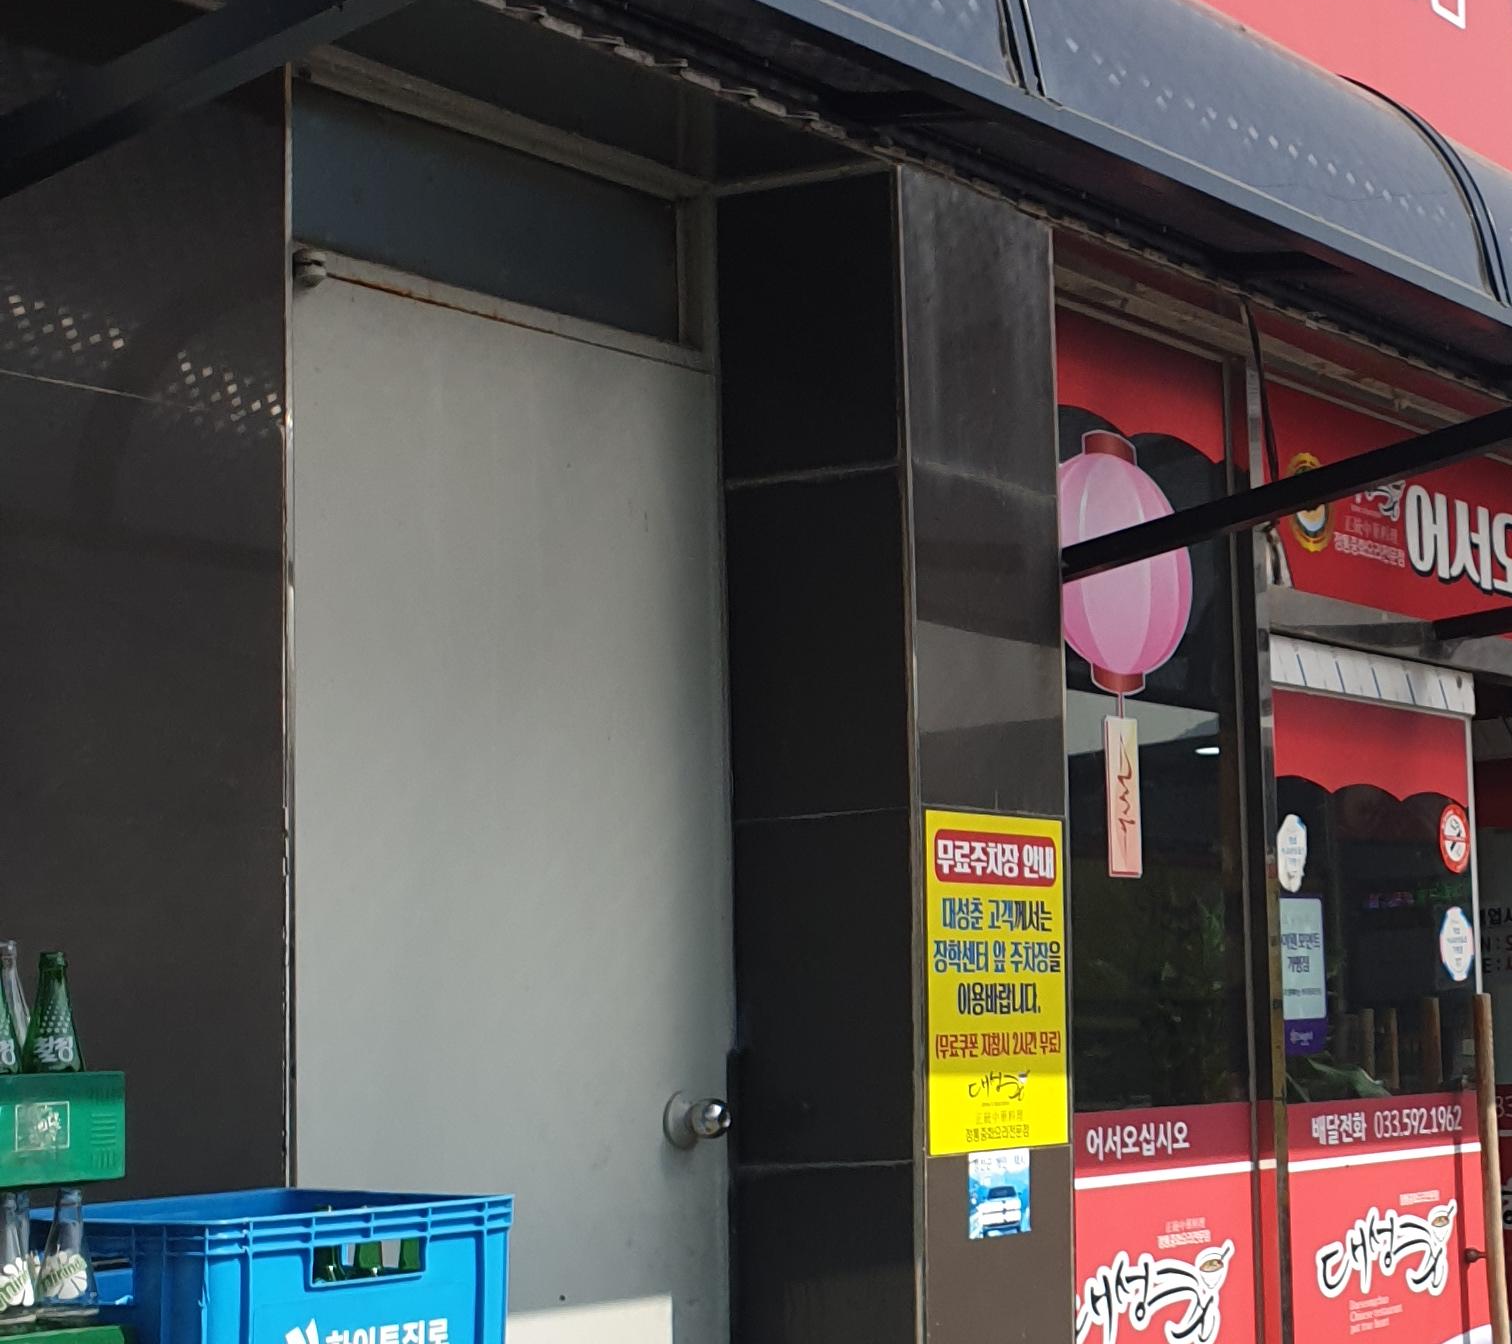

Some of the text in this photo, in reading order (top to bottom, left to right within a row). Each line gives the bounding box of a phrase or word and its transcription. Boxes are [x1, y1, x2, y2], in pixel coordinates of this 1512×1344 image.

[937, 839, 1054, 879] 무료주차장 안내
[942, 897, 1053, 932] 대성춘 고객께서는
[933, 939, 1061, 973] 장학센터 앞 주차장을
[957, 982, 1041, 1016] 이용바랍니다.
[1086, 1120, 1190, 1161] 어서오십시오
[1311, 1112, 1368, 1145] 배달전화
